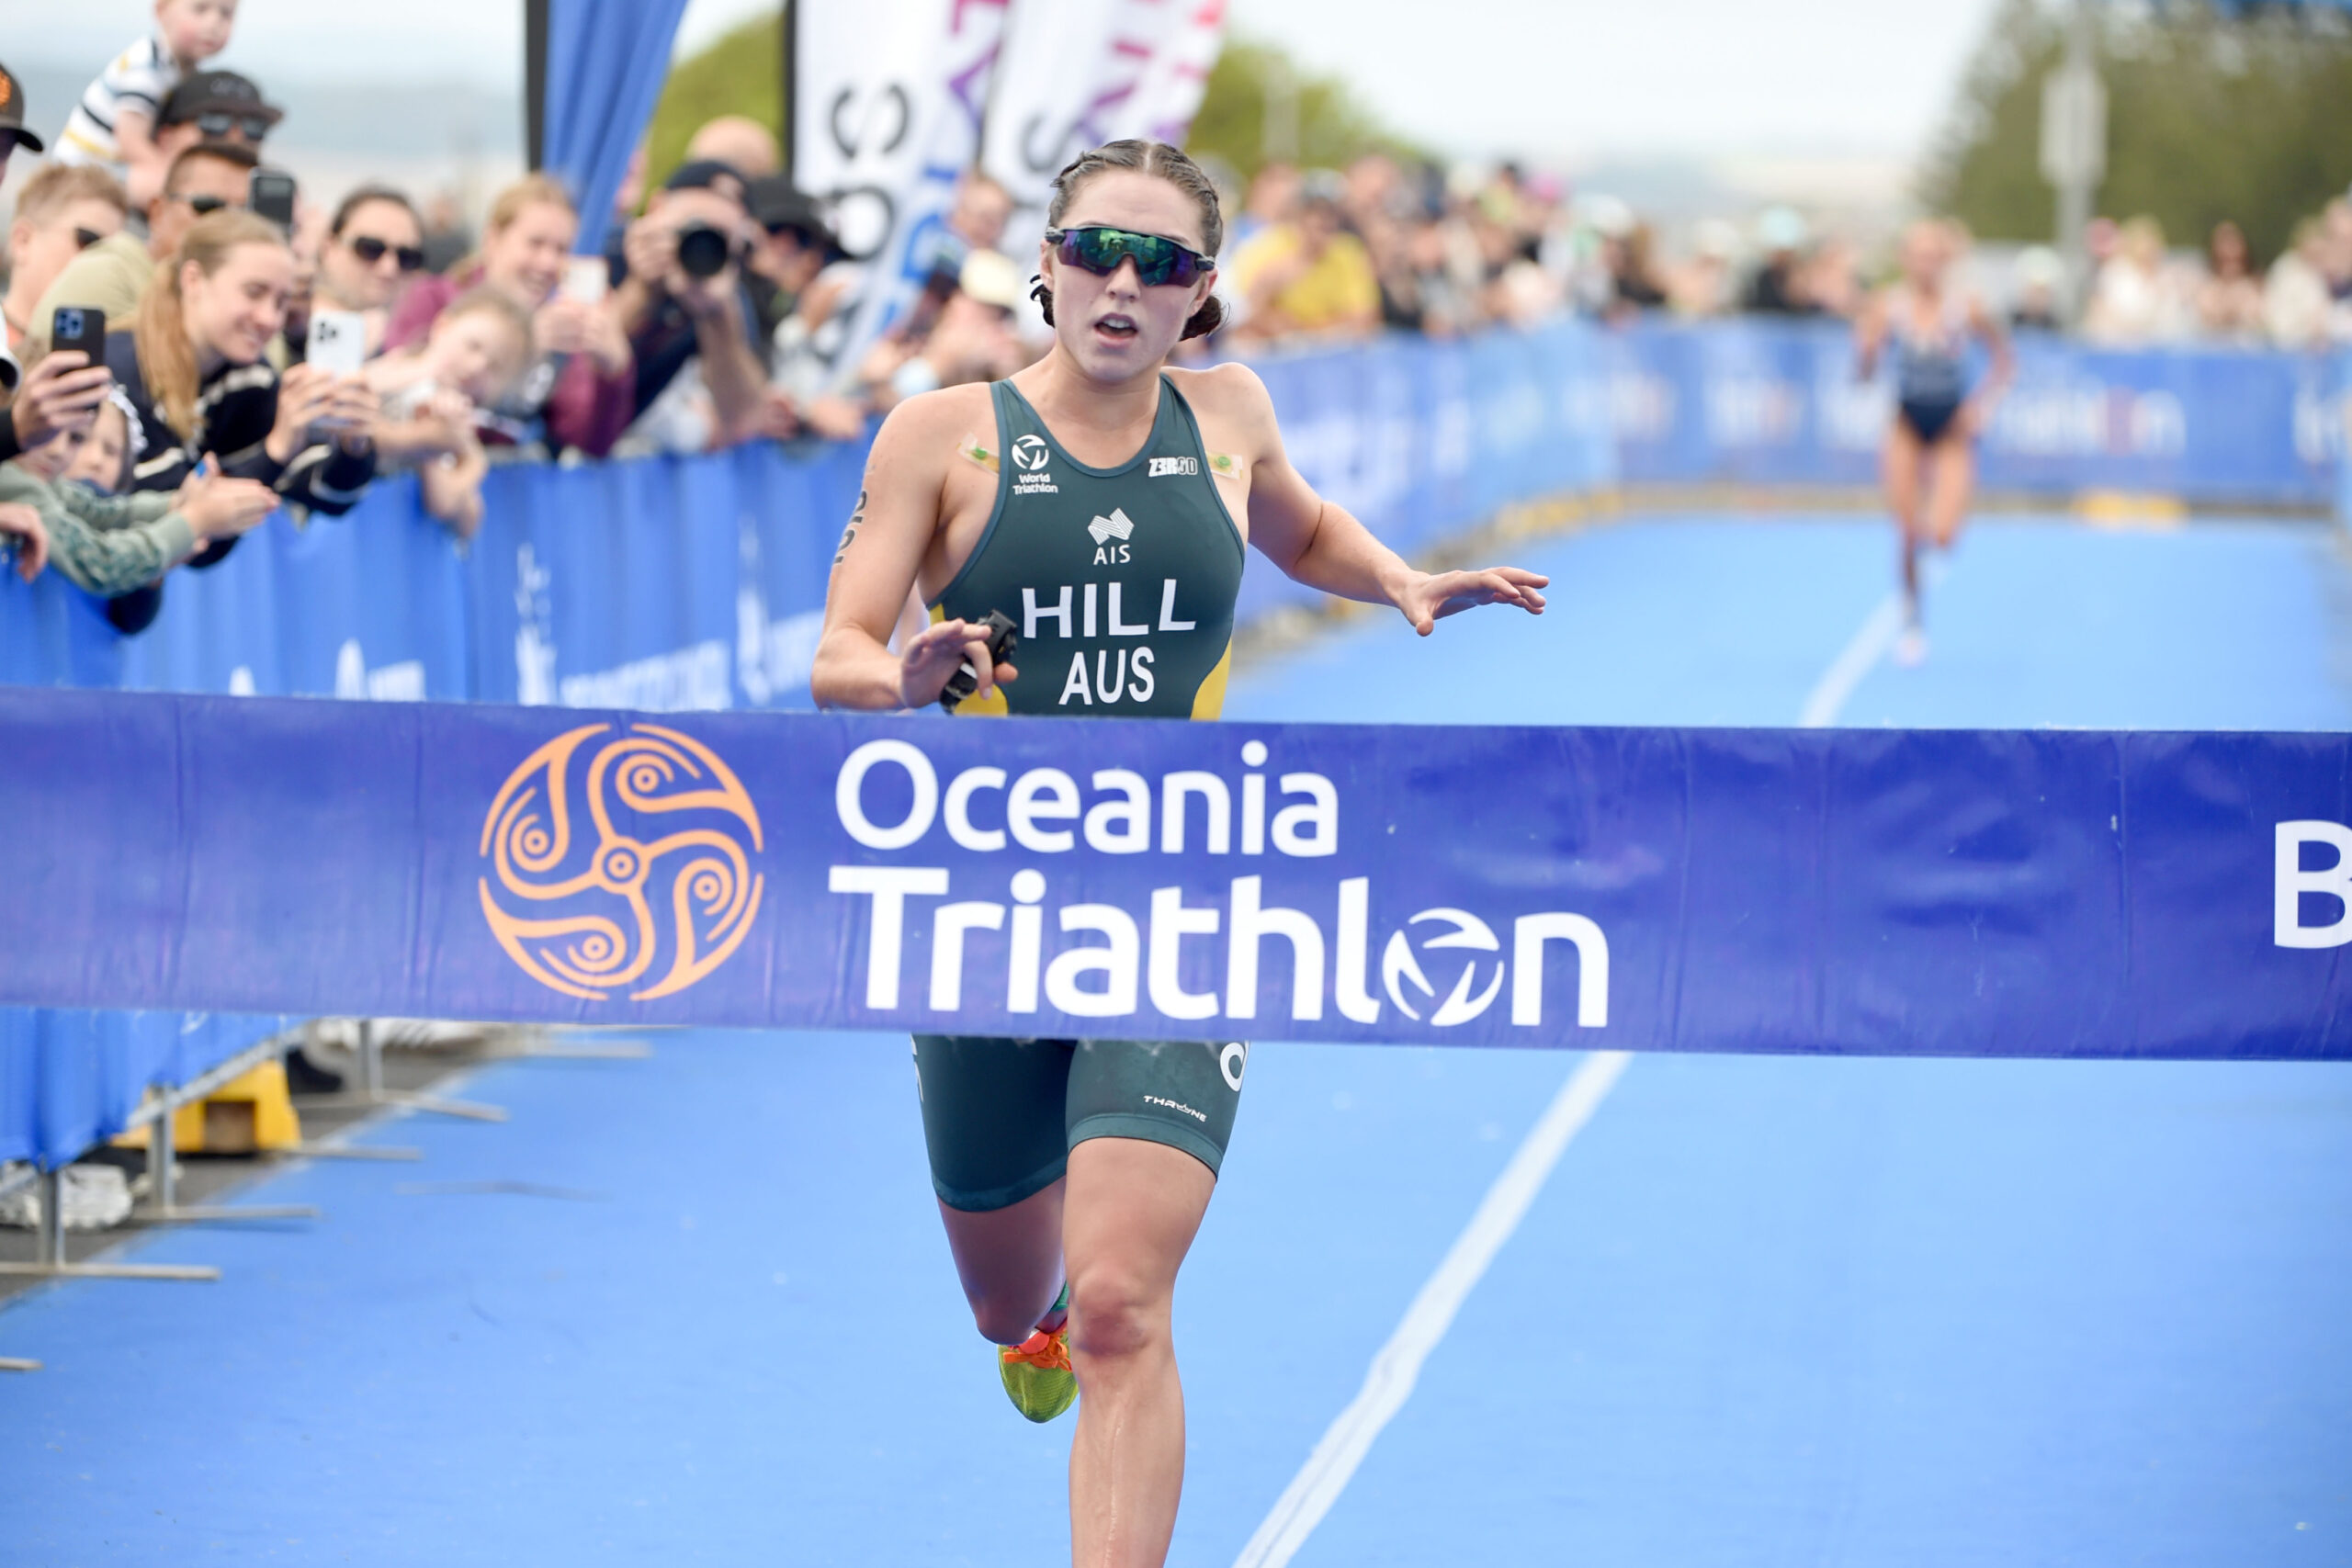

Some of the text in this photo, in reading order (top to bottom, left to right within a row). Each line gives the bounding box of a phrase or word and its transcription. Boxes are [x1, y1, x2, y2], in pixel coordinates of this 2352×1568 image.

[1012, 482, 1059, 496] Triathlon
[1018, 472, 1051, 484] World
[1093, 544, 1131, 566] AIS
[1022, 578, 1196, 638] HILL
[1058, 646, 1155, 705] AUS
[835, 739, 1338, 858] Oceania
[828, 865, 1610, 1029] Triathlon
